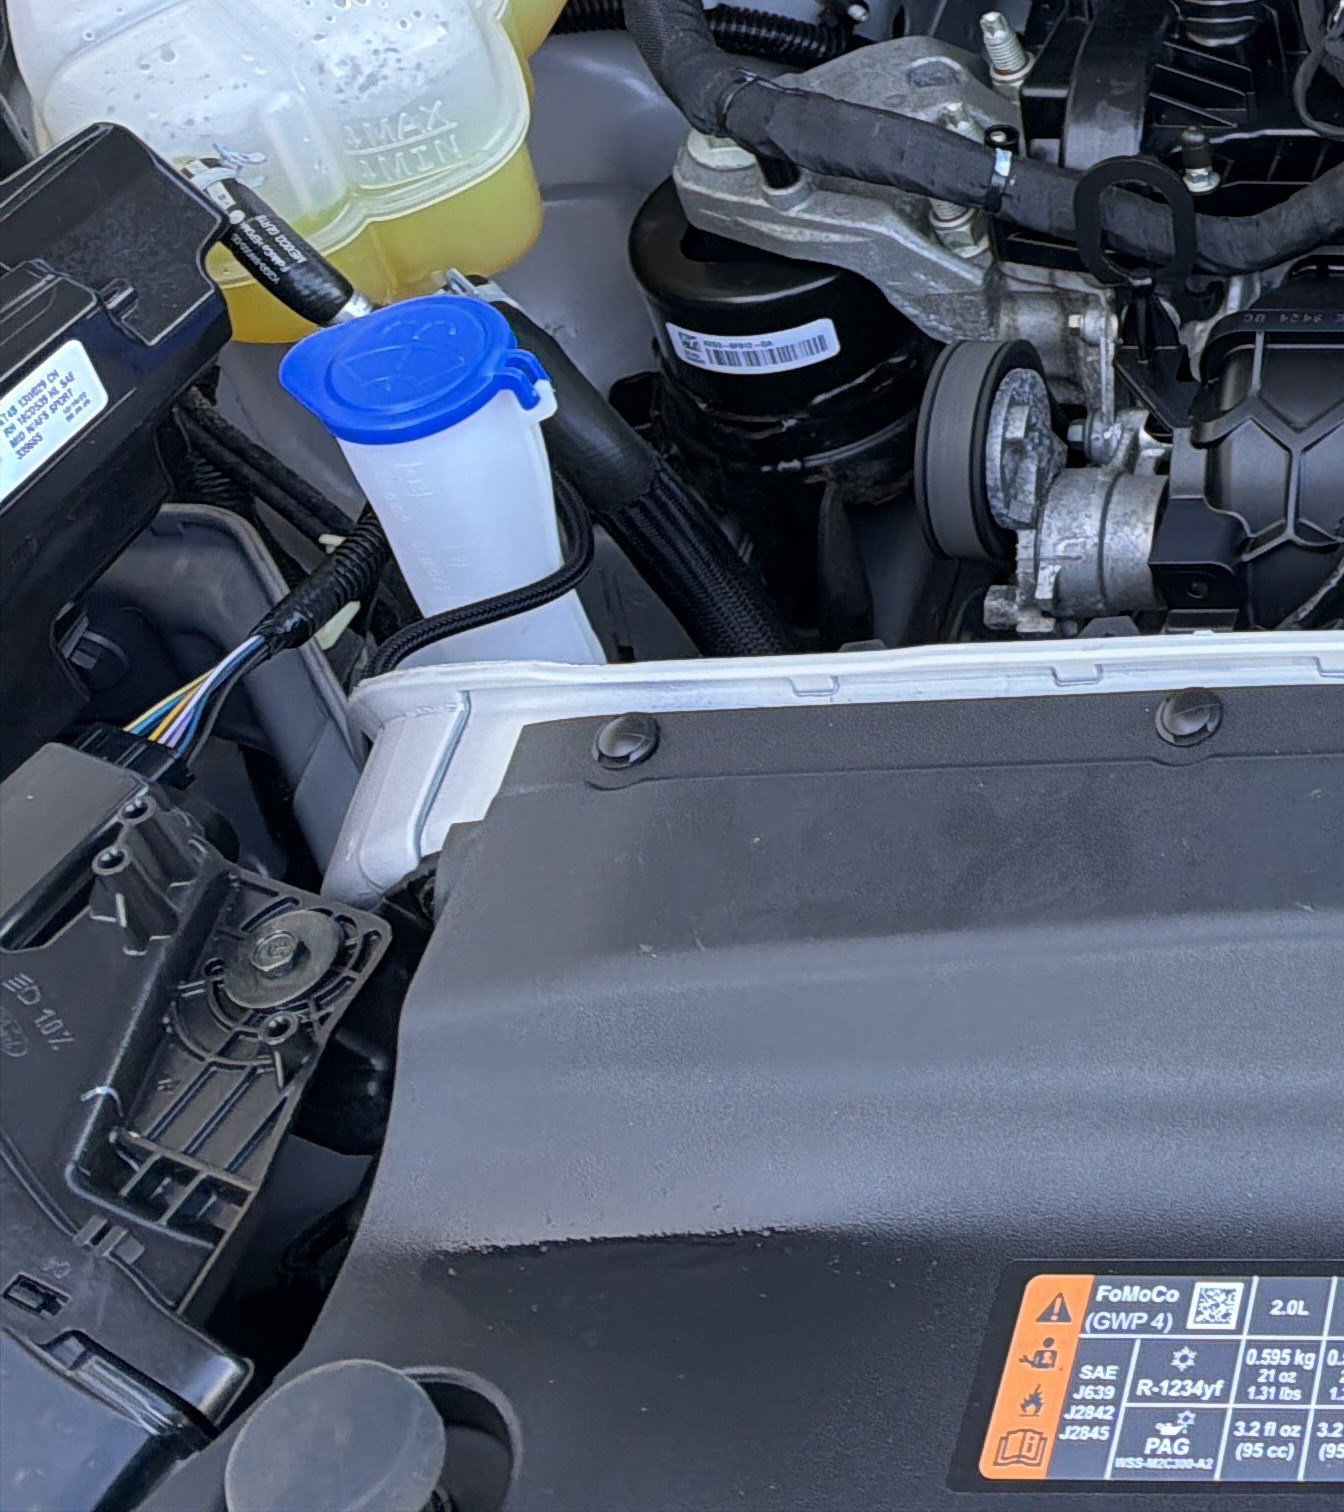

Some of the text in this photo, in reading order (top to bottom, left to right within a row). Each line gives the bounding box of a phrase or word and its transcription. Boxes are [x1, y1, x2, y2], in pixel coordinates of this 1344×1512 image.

[362, 100, 458, 148] MAX
[377, 133, 464, 181] MIN
[49, 388, 73, 414] SPORT
[1095, 1285, 1180, 1303] FoMoCo
[1268, 1299, 1310, 1316] 2.0L
[1085, 1311, 1173, 1334] (GWP 4)
[1245, 1348, 1317, 1371] 0.595 kg
[1078, 1364, 1120, 1381] SAE
[1256, 1368, 1297, 1384] 21 oz
[1072, 1384, 1116, 1400] J639
[1135, 1378, 1226, 1401] R-1234yf
[1246, 1386, 1302, 1402] 1.31 lbs
[1063, 1404, 1116, 1421] J2842
[1058, 1424, 1111, 1441] J2845
[1232, 1420, 1302, 1438] 3.2 fl oz
[1316, 1421, 1344, 1439] 3.2
[1143, 1437, 1191, 1456] PAG
[1234, 1442, 1295, 1462] (95 cc)
